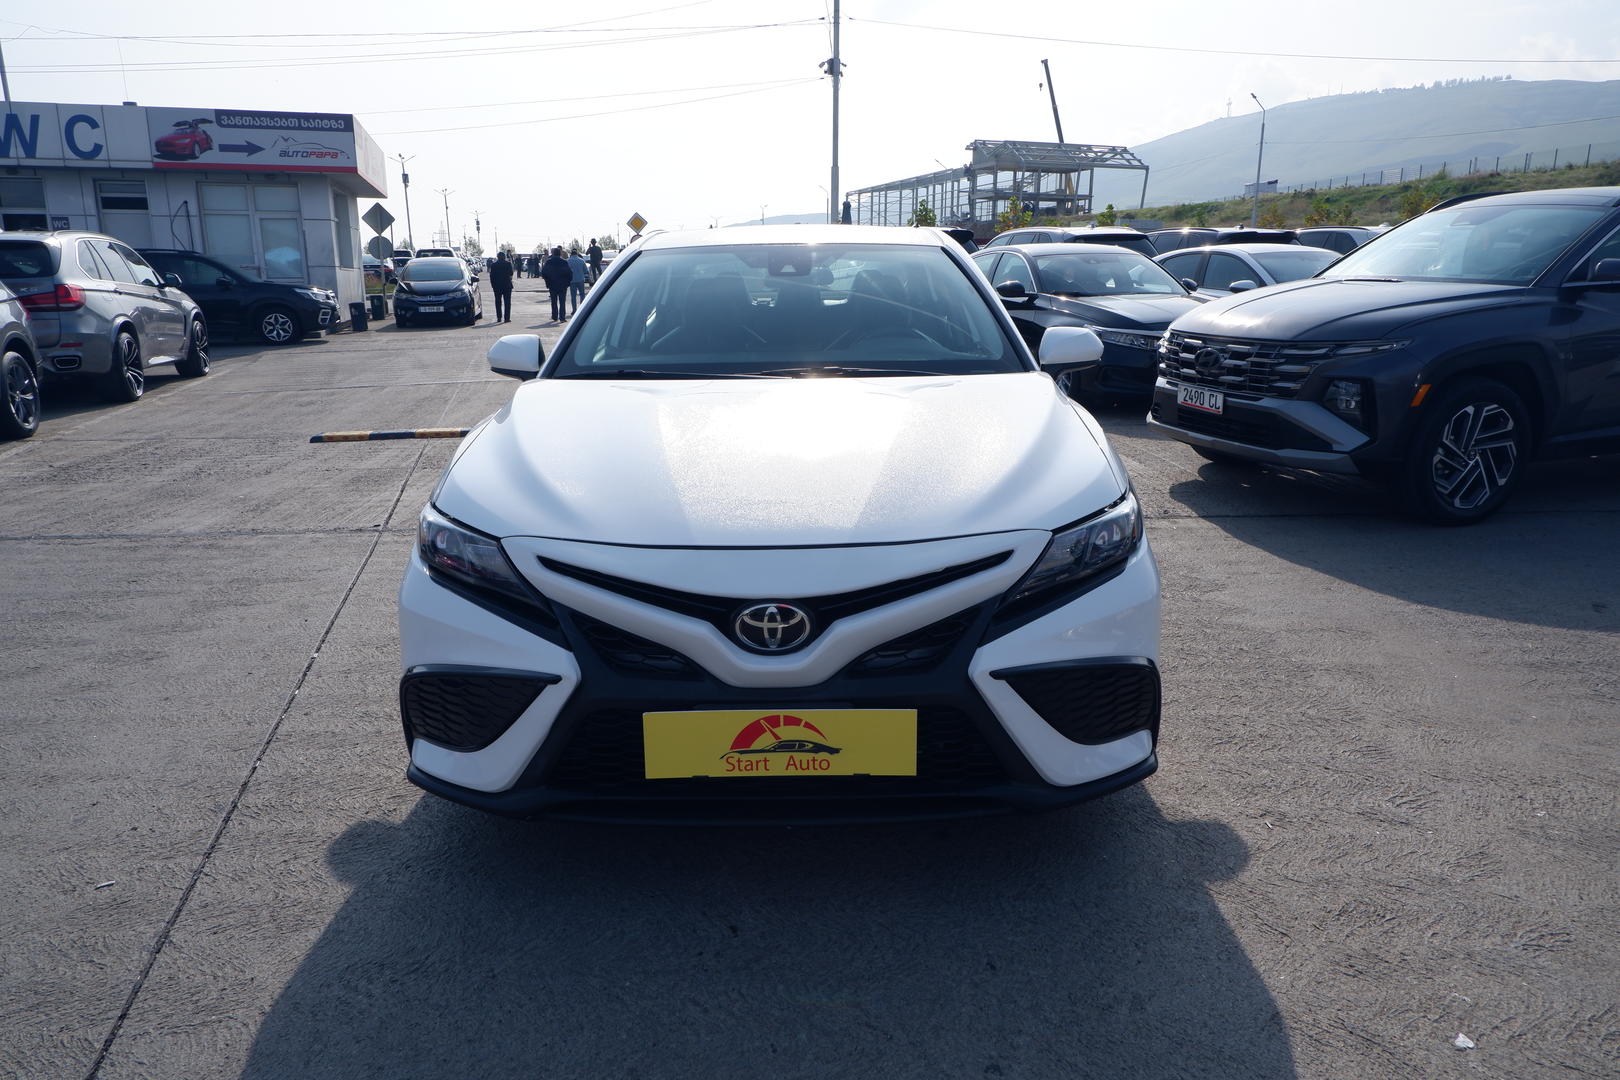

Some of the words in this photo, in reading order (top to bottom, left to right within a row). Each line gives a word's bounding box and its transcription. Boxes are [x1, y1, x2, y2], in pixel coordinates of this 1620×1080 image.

[53, 220, 68, 230] WC
[1183, 387, 1205, 406] 2490
[1208, 393, 1220, 410] CL
[725, 756, 770, 772] Start
[785, 755, 830, 771] Auto
